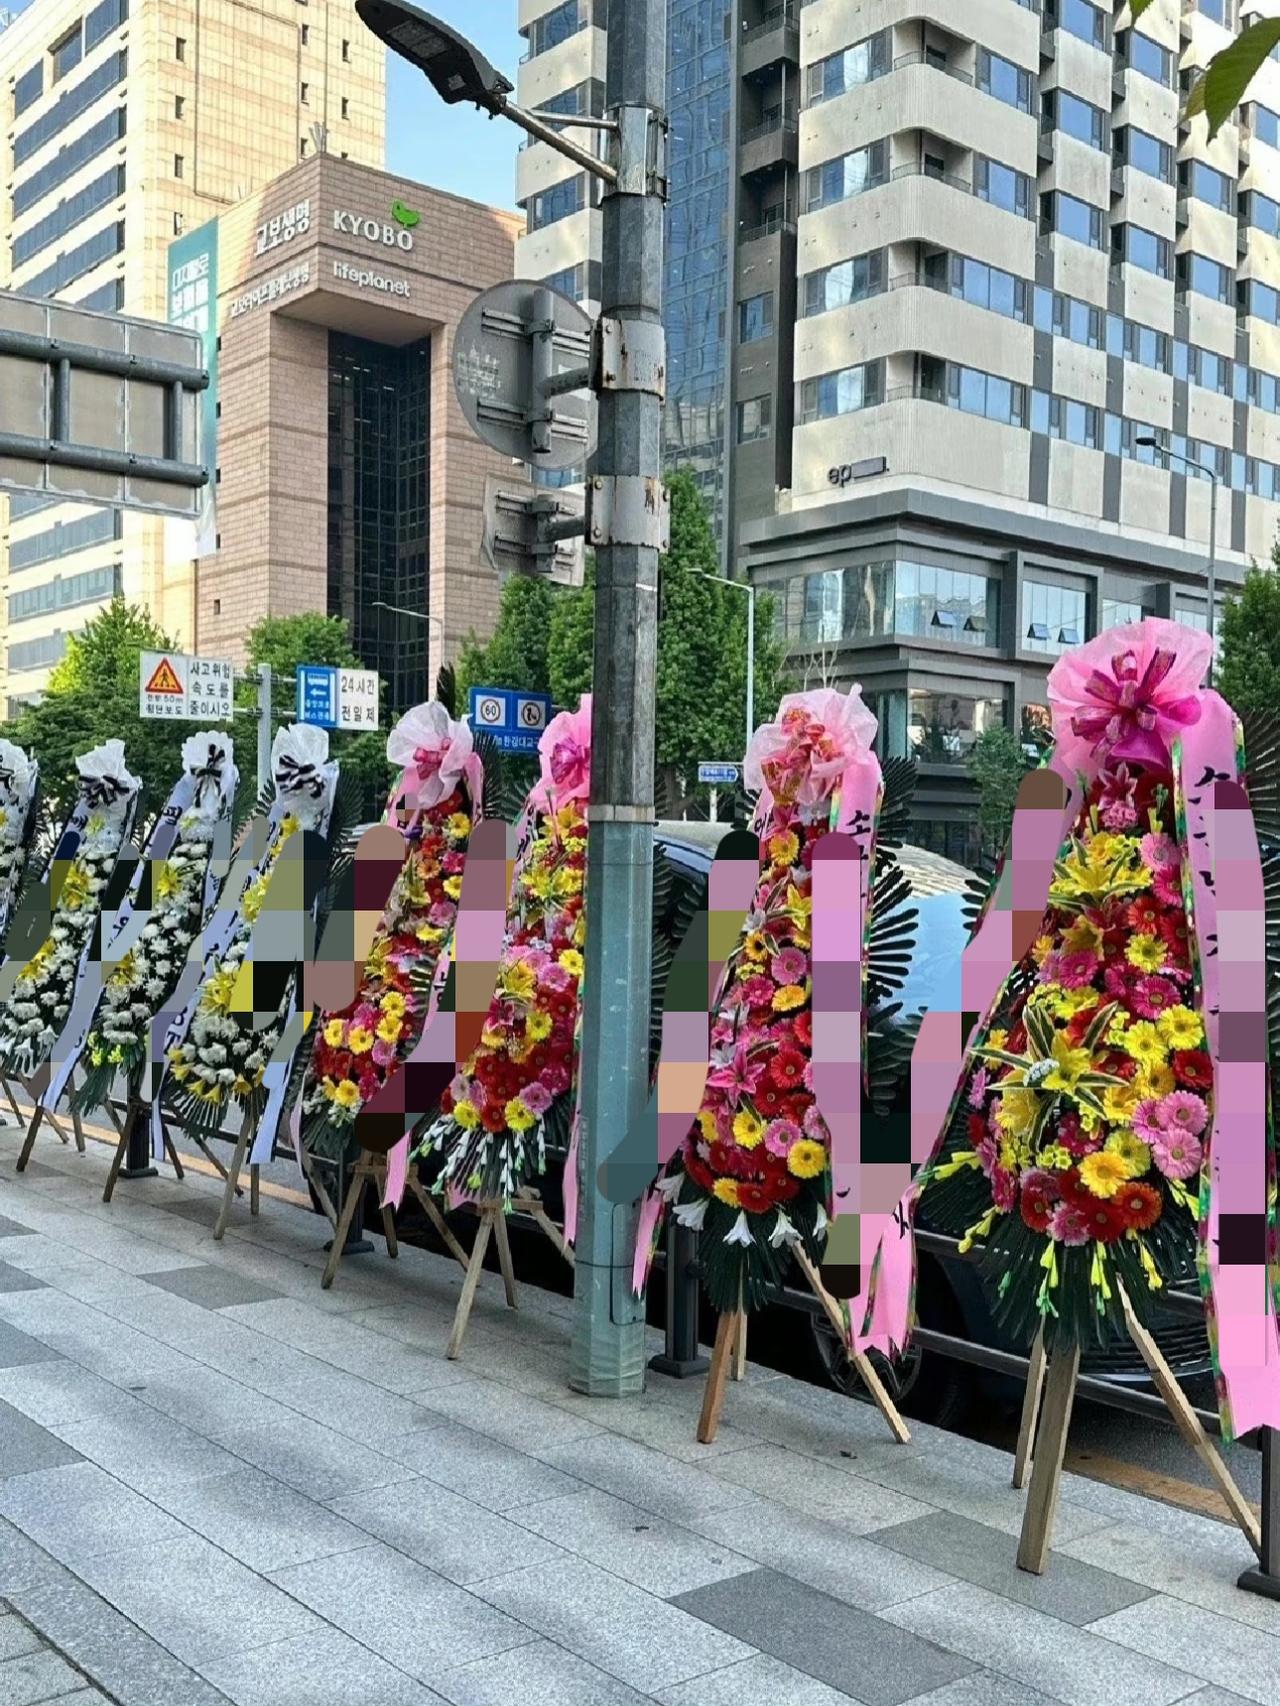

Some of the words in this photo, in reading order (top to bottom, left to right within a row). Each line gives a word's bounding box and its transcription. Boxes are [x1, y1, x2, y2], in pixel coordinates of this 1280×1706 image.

[255, 199, 310, 257] 교보생명
[333, 210, 413, 250] KYOBO
[333, 260, 411, 297] lifeplanet
[231, 261, 309, 318] 교보라이프플래닛생명
[190, 662, 230, 679] 사고위험
[192, 681, 229, 699] 속도를
[341, 675, 375, 695] 24시간
[146, 703, 183, 715] 횡단보도
[190, 700, 230, 717] 줄이시오
[341, 705, 375, 722] 전일제
[485, 705, 497, 716] 60
